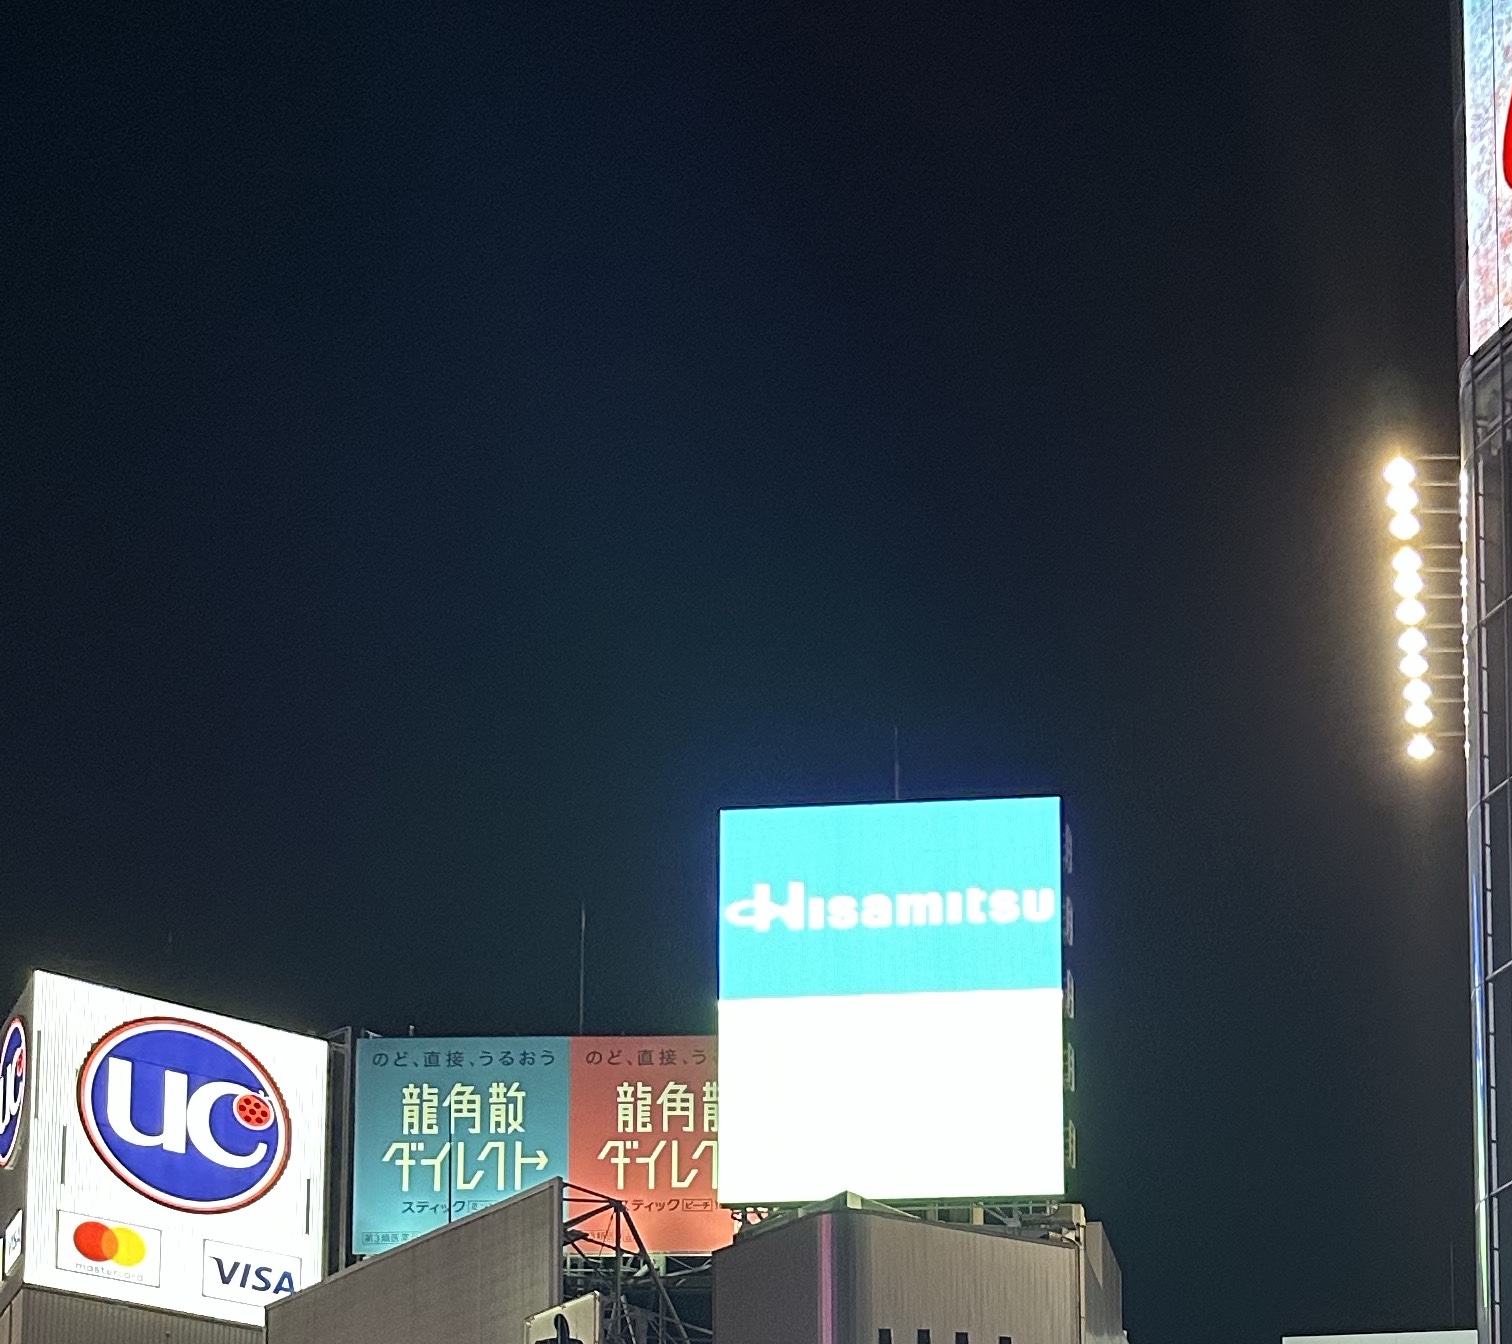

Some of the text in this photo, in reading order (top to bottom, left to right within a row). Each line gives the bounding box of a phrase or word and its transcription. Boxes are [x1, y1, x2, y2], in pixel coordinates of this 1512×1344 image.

[724, 881, 1055, 932] Hisamitsu
[372, 1050, 556, 1068] のど、直接、うるおう
[401, 1081, 526, 1135] 龍角散
[381, 1140, 549, 1192] ダイレクト
[401, 1200, 466, 1213] スティック
[76, 1261, 144, 1282] mastercard
[208, 1255, 295, 1295] VISA
